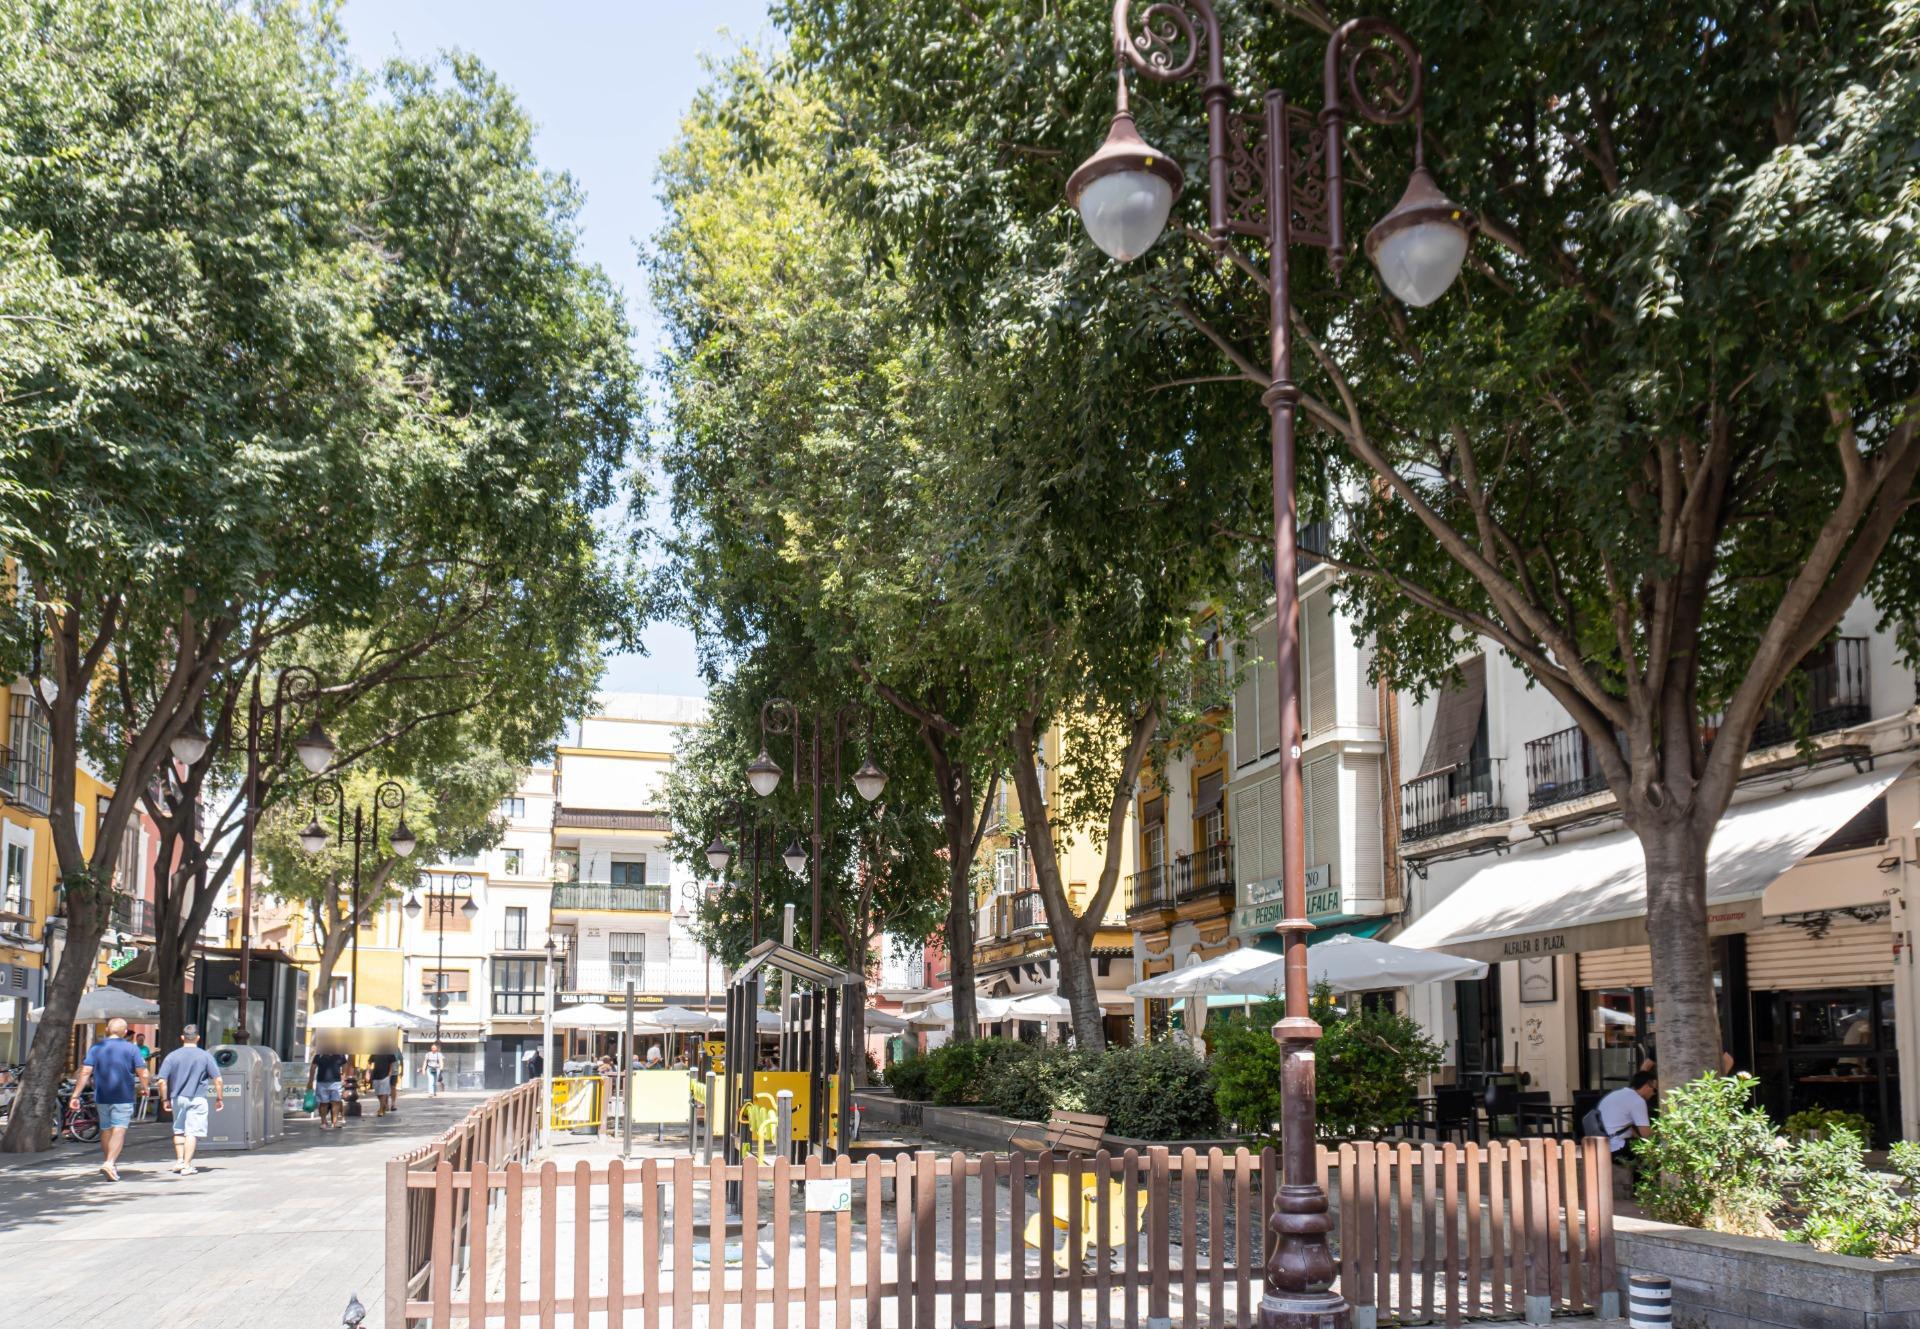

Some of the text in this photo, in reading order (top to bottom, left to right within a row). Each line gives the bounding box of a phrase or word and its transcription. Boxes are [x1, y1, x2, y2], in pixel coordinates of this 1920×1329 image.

[1504, 940, 1531, 956] ALFALFA
[1543, 935, 1566, 950] PLAZA
[561, 995, 578, 1003] CASA
